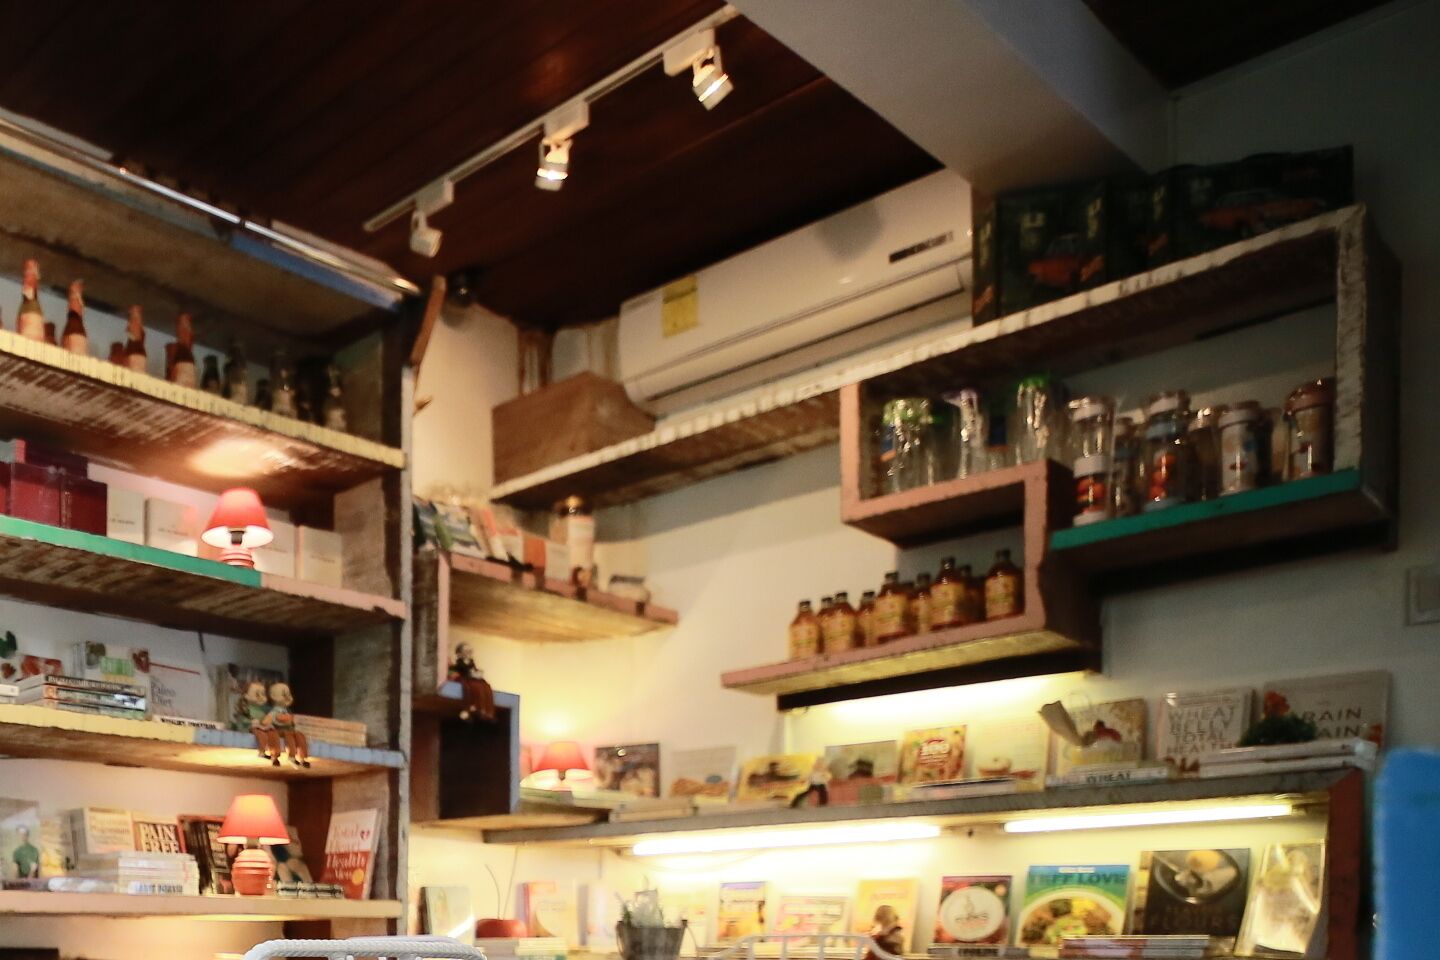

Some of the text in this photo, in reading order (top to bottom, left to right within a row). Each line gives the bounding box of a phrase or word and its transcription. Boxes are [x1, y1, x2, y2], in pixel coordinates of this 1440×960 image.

[1302, 707, 1363, 722] RAIN
[140, 823, 177, 841] PAIN
[142, 839, 180, 854] FREE
